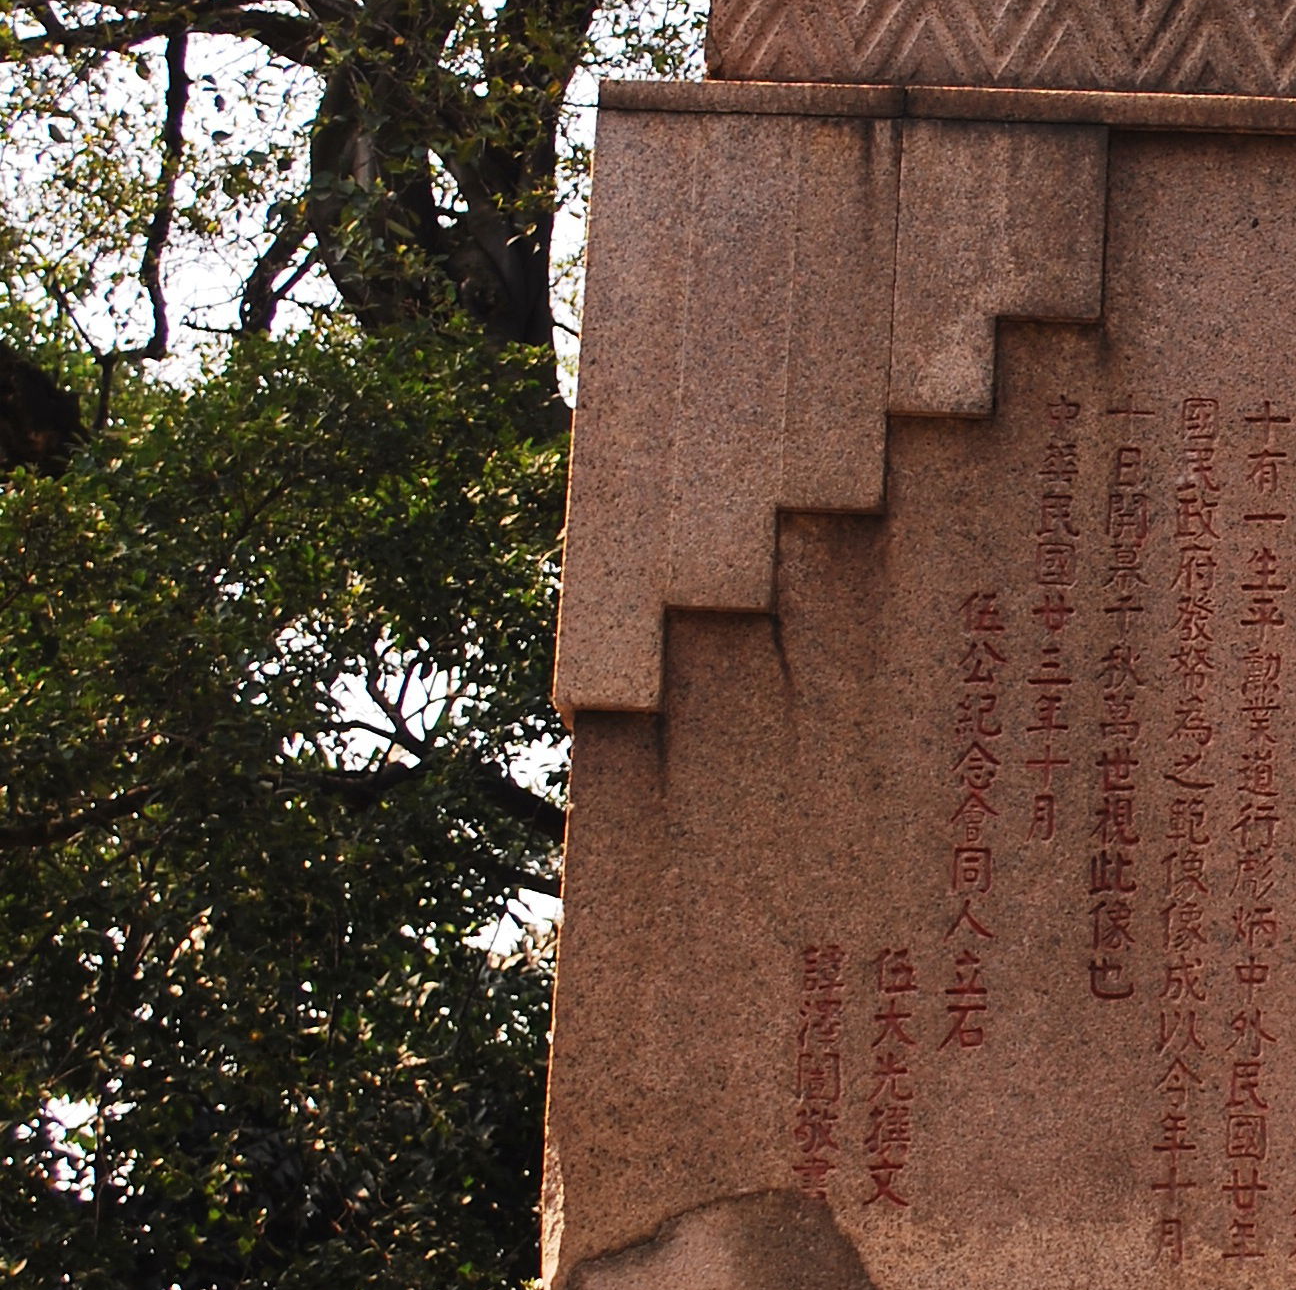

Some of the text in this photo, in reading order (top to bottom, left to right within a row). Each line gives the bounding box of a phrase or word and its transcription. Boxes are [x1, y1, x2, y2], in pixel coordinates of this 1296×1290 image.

[937, 591, 1008, 1051] 伍公紀念會同人立石
[1024, 394, 1081, 843] 中華民國廿三年十月
[1087, 397, 1156, 1001] 十日開幕千秋萬世視此像也
[863, 947, 918, 1207] 伍大光撰文
